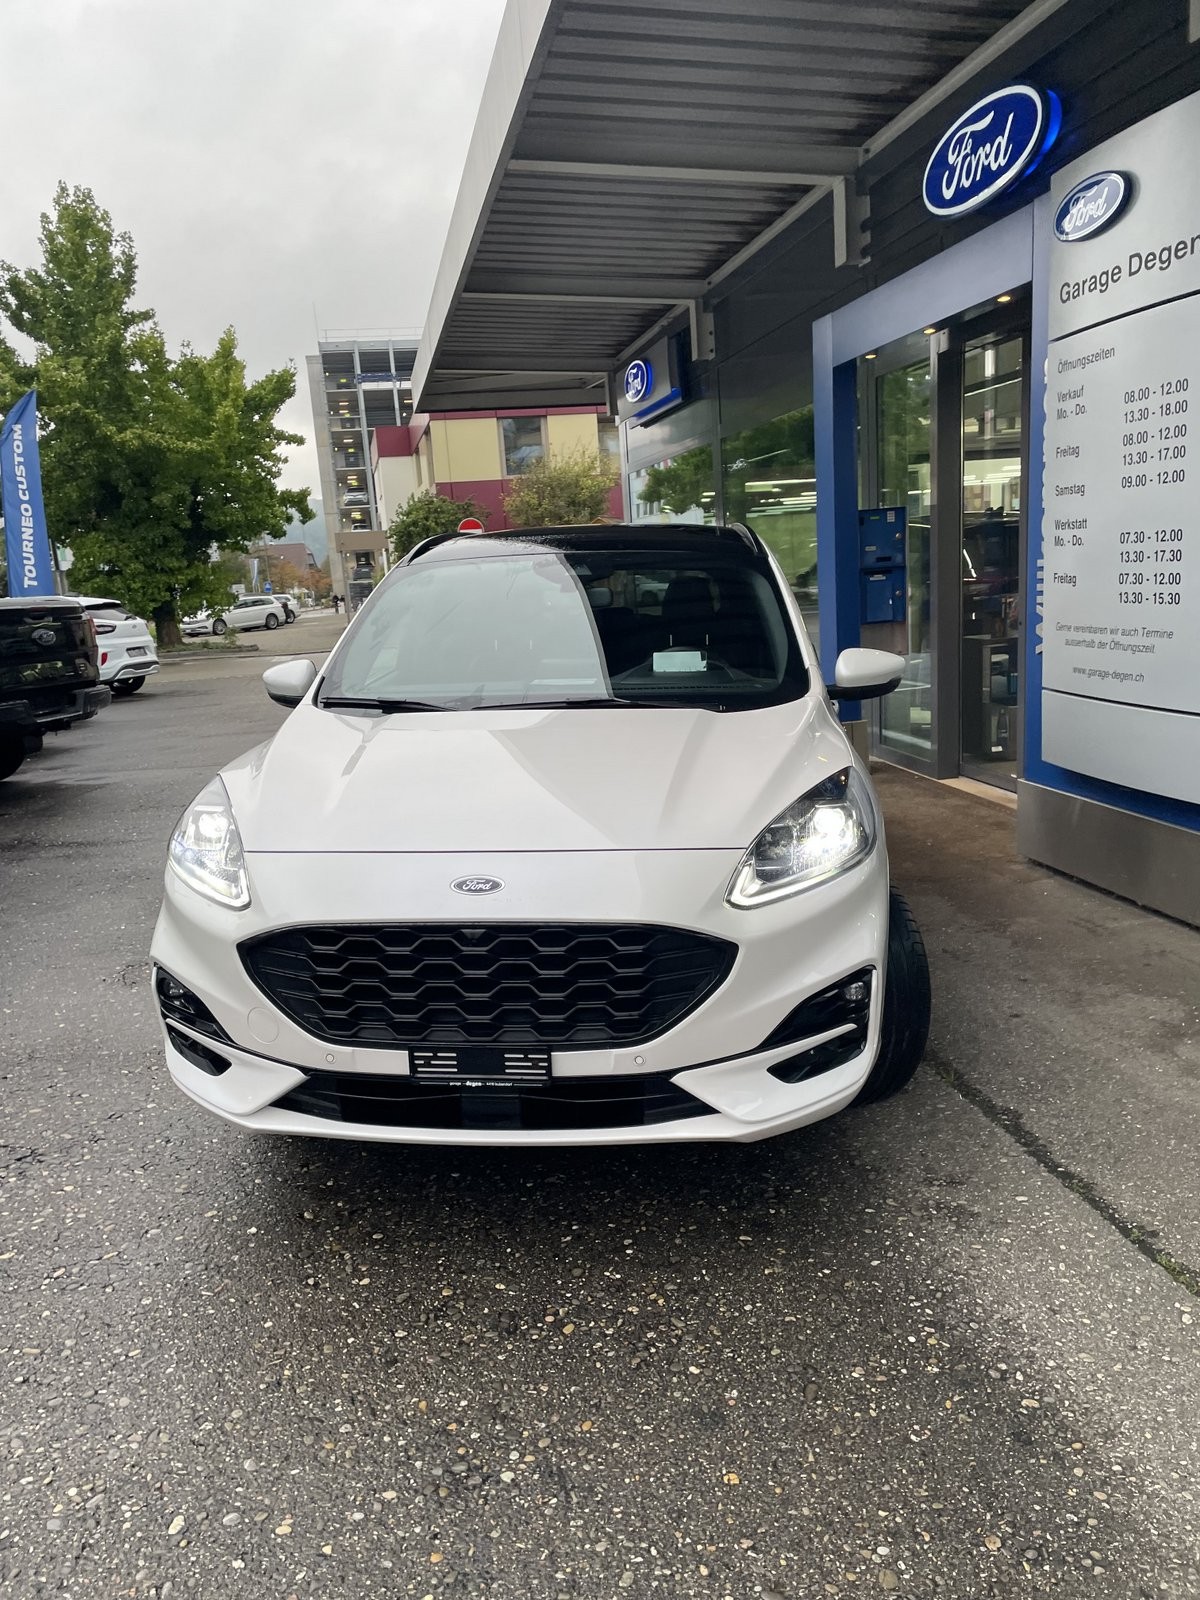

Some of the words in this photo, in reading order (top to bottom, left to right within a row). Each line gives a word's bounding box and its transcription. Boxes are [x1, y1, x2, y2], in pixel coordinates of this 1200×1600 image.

[941, 110, 1015, 200] Ford
[1062, 184, 1109, 232] Ford
[1060, 265, 1122, 304] Garage
[1057, 347, 1115, 374] Öffnungszeiten
[1057, 384, 1085, 403] Verkauf
[1124, 387, 1150, 404] 08.00
[1160, 378, 1189, 396] 12.00
[1057, 408, 1069, 420] Mo.
[1075, 403, 1088, 416] Do.
[1124, 407, 1149, 424] 13.30
[1159, 400, 1188, 417] 18.00
[1122, 430, 1149, 447] 08.00
[1158, 424, 1187, 441] 12.00
[1056, 445, 1080, 459] Freitag
[1122, 451, 1148, 466] 13.30
[1157, 445, 1186, 461] 17.00
[12, 423, 30, 501] CUSTOM
[1121, 474, 1147, 489] 09.00
[1156, 469, 1185, 485] 12.00
[1055, 484, 1086, 497] Samstag
[1054, 518, 1088, 531] Werkstatt
[1054, 536, 1067, 547] Mo.
[1072, 535, 1085, 547] Do.
[1119, 531, 1145, 544] 07.30
[1155, 528, 1183, 543] 12.00
[20, 502, 38, 589] TOURNEO
[1119, 550, 1145, 564] 13.30
[1154, 548, 1182, 563] 17.30
[1053, 572, 1077, 587] Freitag
[1118, 572, 1144, 585] 07.30
[1153, 572, 1182, 586] 12.00
[1118, 592, 1143, 604] 13.30
[1152, 592, 1181, 605] 15.30
[1109, 626, 1120, 636] wir
[1120, 627, 1139, 638] auch
[1141, 627, 1174, 640] Termine
[1096, 639, 1109, 650] der
[462, 879, 493, 890] Ford
